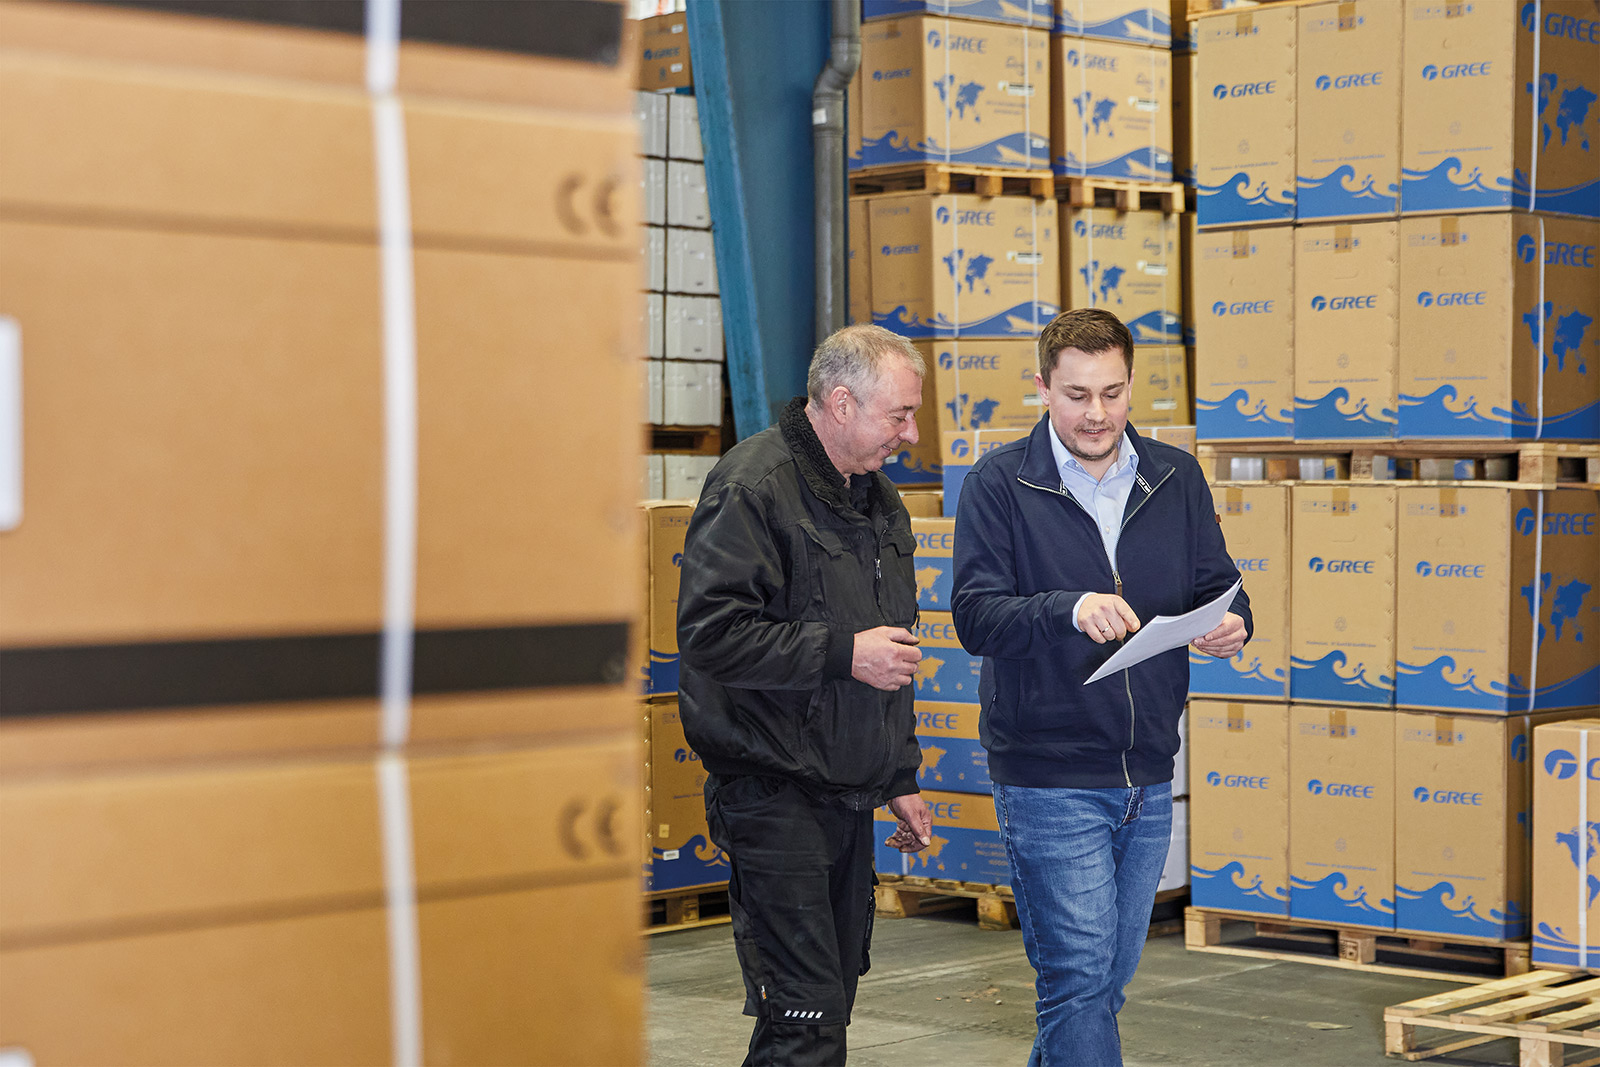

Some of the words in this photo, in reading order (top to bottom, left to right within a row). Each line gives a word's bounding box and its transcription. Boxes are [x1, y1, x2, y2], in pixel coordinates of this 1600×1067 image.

[1544, 13, 1600, 45] GREE
[1438, 61, 1492, 79] GREE
[1231, 80, 1277, 98] GREE
[1335, 72, 1384, 90] GREE
[953, 209, 996, 226] GREE
[1542, 241, 1596, 268] GREE
[1330, 295, 1378, 311] GREE
[1436, 291, 1488, 307] GREE
[1229, 300, 1276, 316] GREE
[958, 355, 1000, 370] GREE
[1541, 513, 1596, 535] GREE
[914, 532, 953, 549] REE
[1233, 558, 1270, 572] REE
[1327, 560, 1375, 574] GREE
[1435, 564, 1486, 579] GREE
[913, 622, 956, 640] REE
[915, 711, 960, 730] REE
[1224, 774, 1271, 790] GREE
[1326, 783, 1375, 799] GREE
[1433, 790, 1484, 807] GREE
